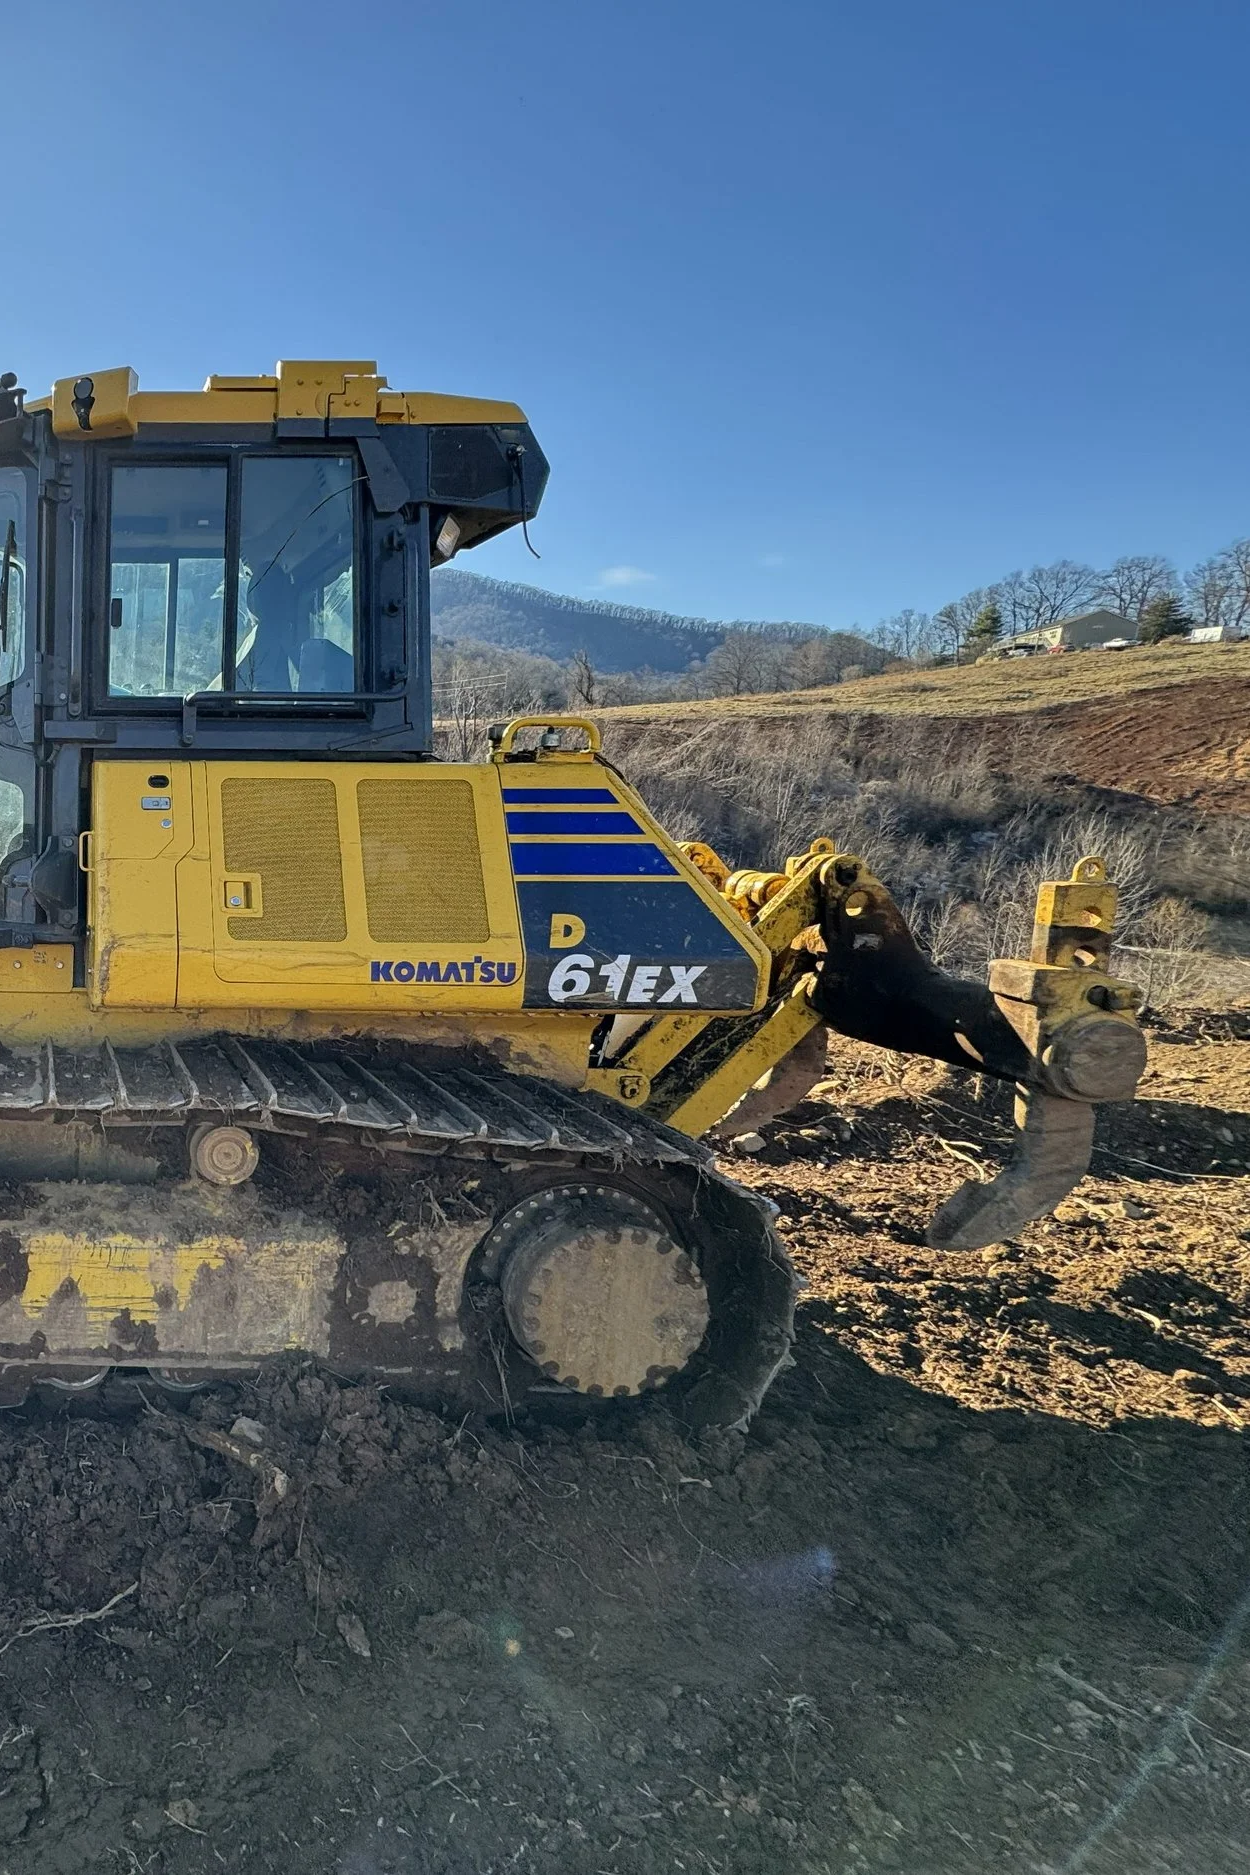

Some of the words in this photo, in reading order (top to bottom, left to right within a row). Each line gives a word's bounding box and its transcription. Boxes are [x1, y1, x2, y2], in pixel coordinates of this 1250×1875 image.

[549, 913, 586, 949] D
[370, 955, 517, 983] KOMATSU
[548, 953, 708, 1003] 61EX
